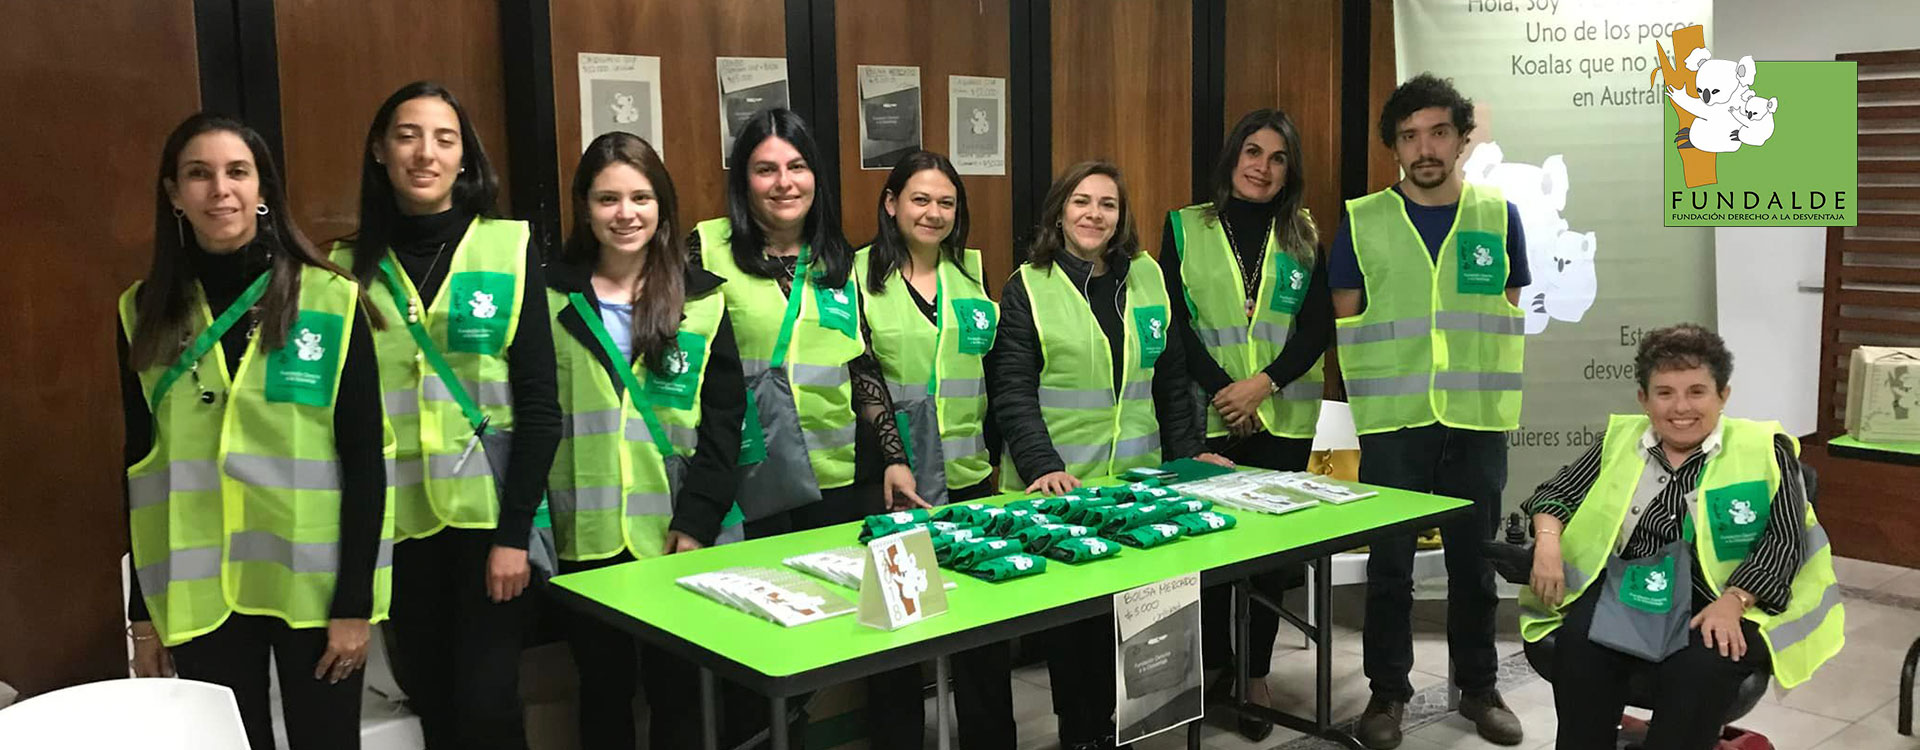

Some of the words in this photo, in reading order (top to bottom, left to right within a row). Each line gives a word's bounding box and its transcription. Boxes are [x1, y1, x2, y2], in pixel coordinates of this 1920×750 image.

[1526, 20, 1567, 43] Uno
[1574, 20, 1597, 41] de
[1604, 19, 1630, 40] los
[1638, 21, 1695, 44] poc
[1511, 54, 1573, 76] Koalas
[1579, 57, 1614, 79] que
[1622, 55, 1647, 72] no
[1572, 91, 1594, 107] en
[1506, 426, 1560, 449] uieres
[1123, 587, 1156, 604] BOLSA
[1159, 576, 1198, 595] MERCADO
